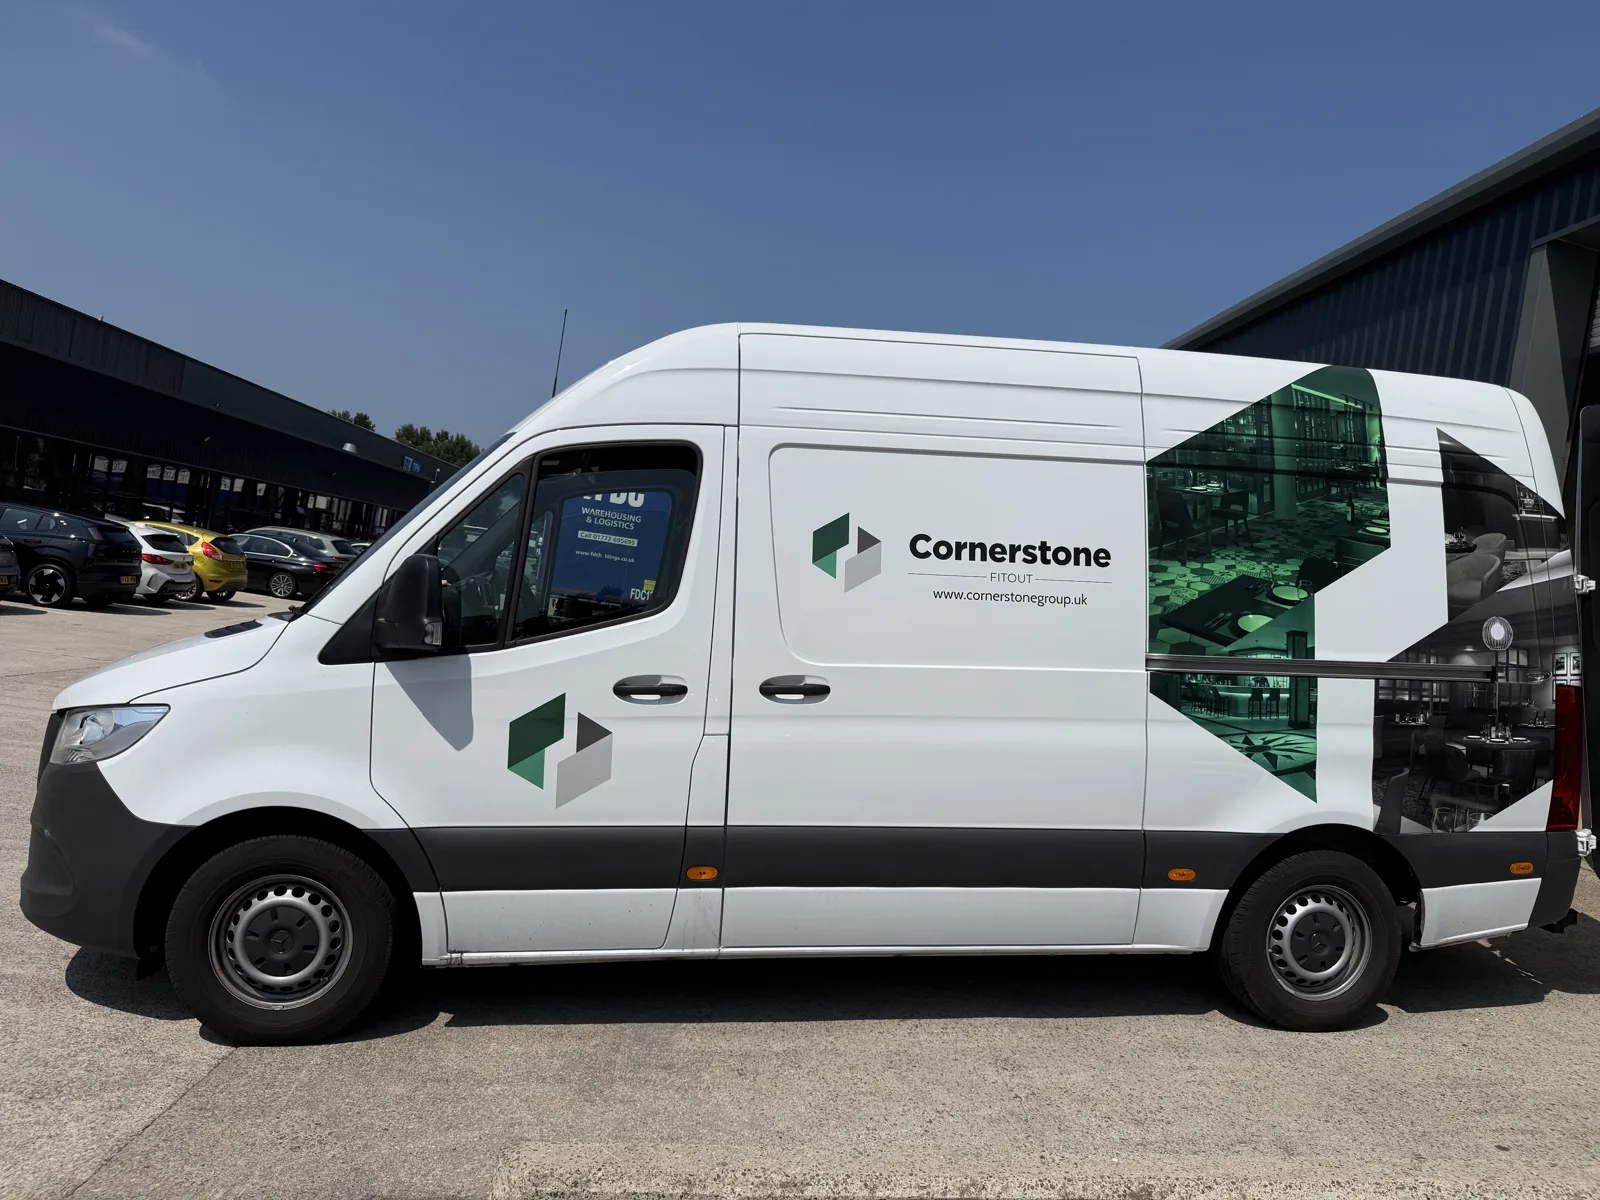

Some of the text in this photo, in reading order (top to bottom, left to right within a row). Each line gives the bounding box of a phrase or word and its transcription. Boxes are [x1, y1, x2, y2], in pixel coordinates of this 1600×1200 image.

[581, 507, 642, 523] WAREHOUSING
[585, 516, 635, 530] & LOGISTICS
[580, 531, 592, 539] Call
[592, 533, 612, 542] 01772
[575, 550, 635, 563] www.fdchldings.co.uk
[909, 533, 1112, 568] Cornerstone
[990, 572, 1034, 584] FITOUT
[933, 590, 1088, 607] www.cornerstonegroup.uk
